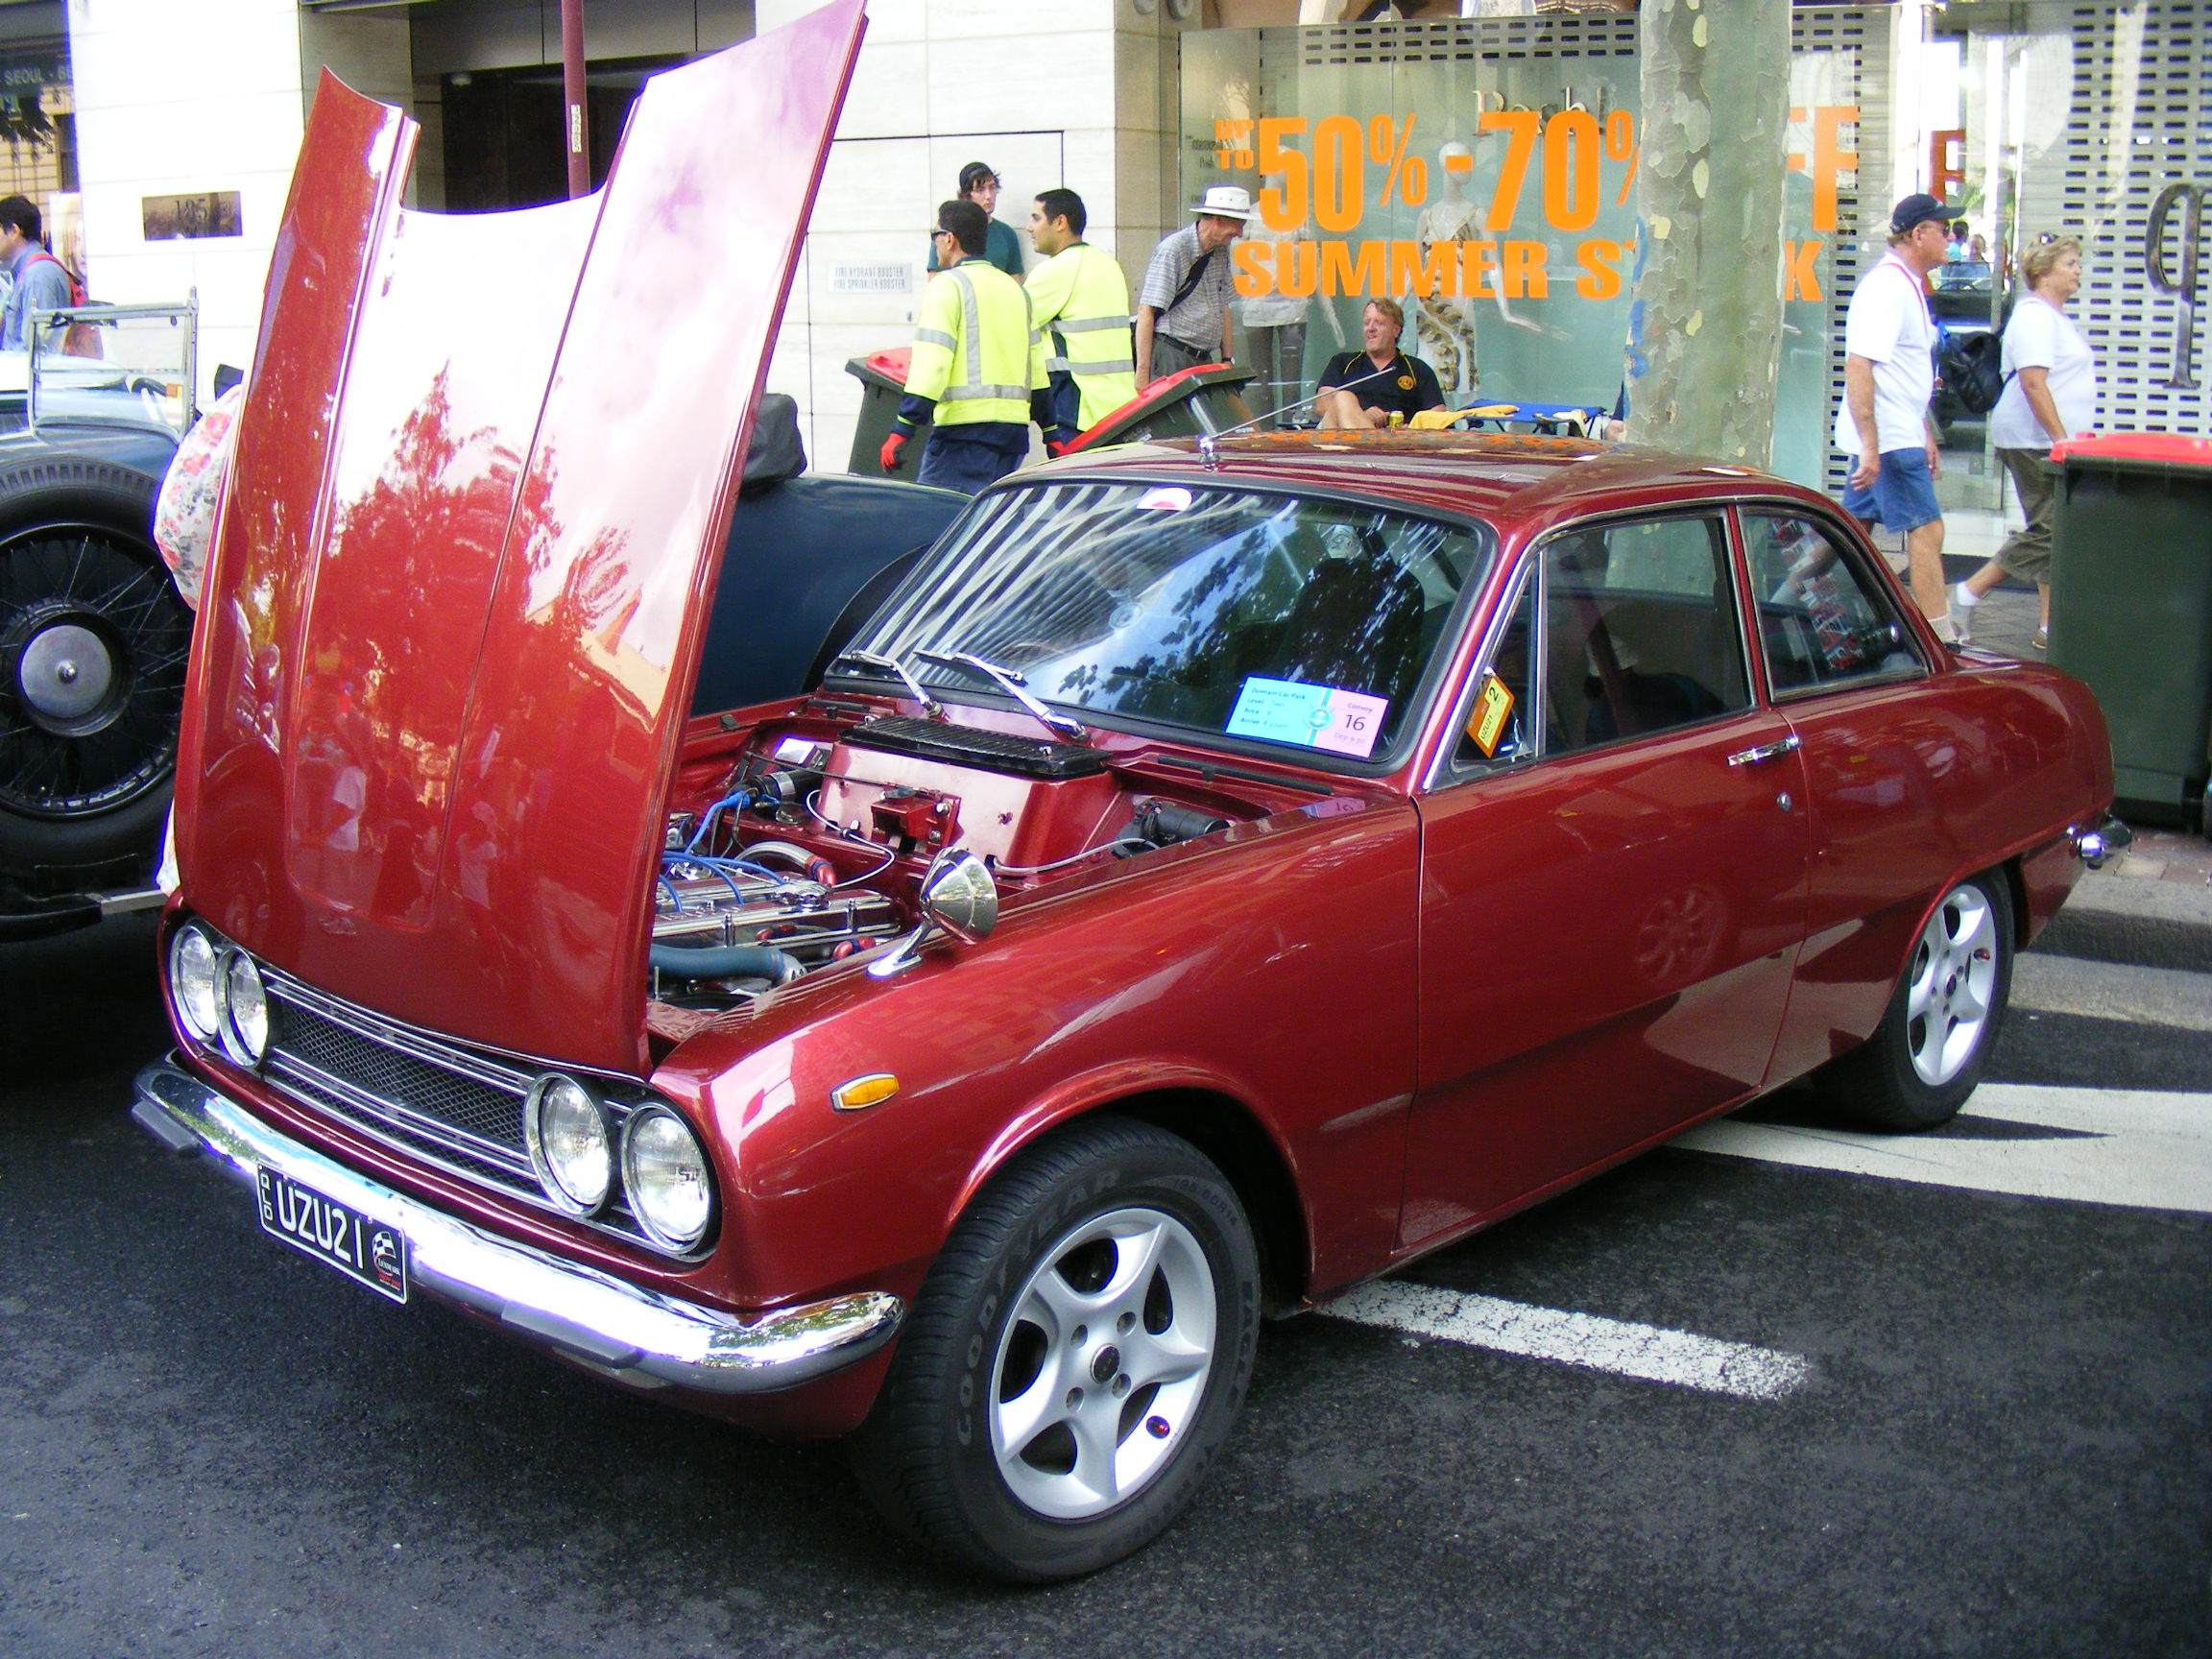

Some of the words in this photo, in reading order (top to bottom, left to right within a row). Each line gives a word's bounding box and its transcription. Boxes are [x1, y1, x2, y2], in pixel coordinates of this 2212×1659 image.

[4, 67, 45, 86] SEOUL
[1214, 119, 1254, 139] UP
[1214, 149, 1254, 170] TO
[1259, 112, 1427, 231] 50%
[878, 266, 903, 277] BOOSTER
[1233, 239, 1549, 300] SUMMER
[879, 278, 905, 289] BOOSTER
[1251, 687, 1278, 696] Domain
[1489, 686, 1500, 702] 2
[1347, 702, 1373, 713] Convoy
[1346, 714, 1366, 731] 16
